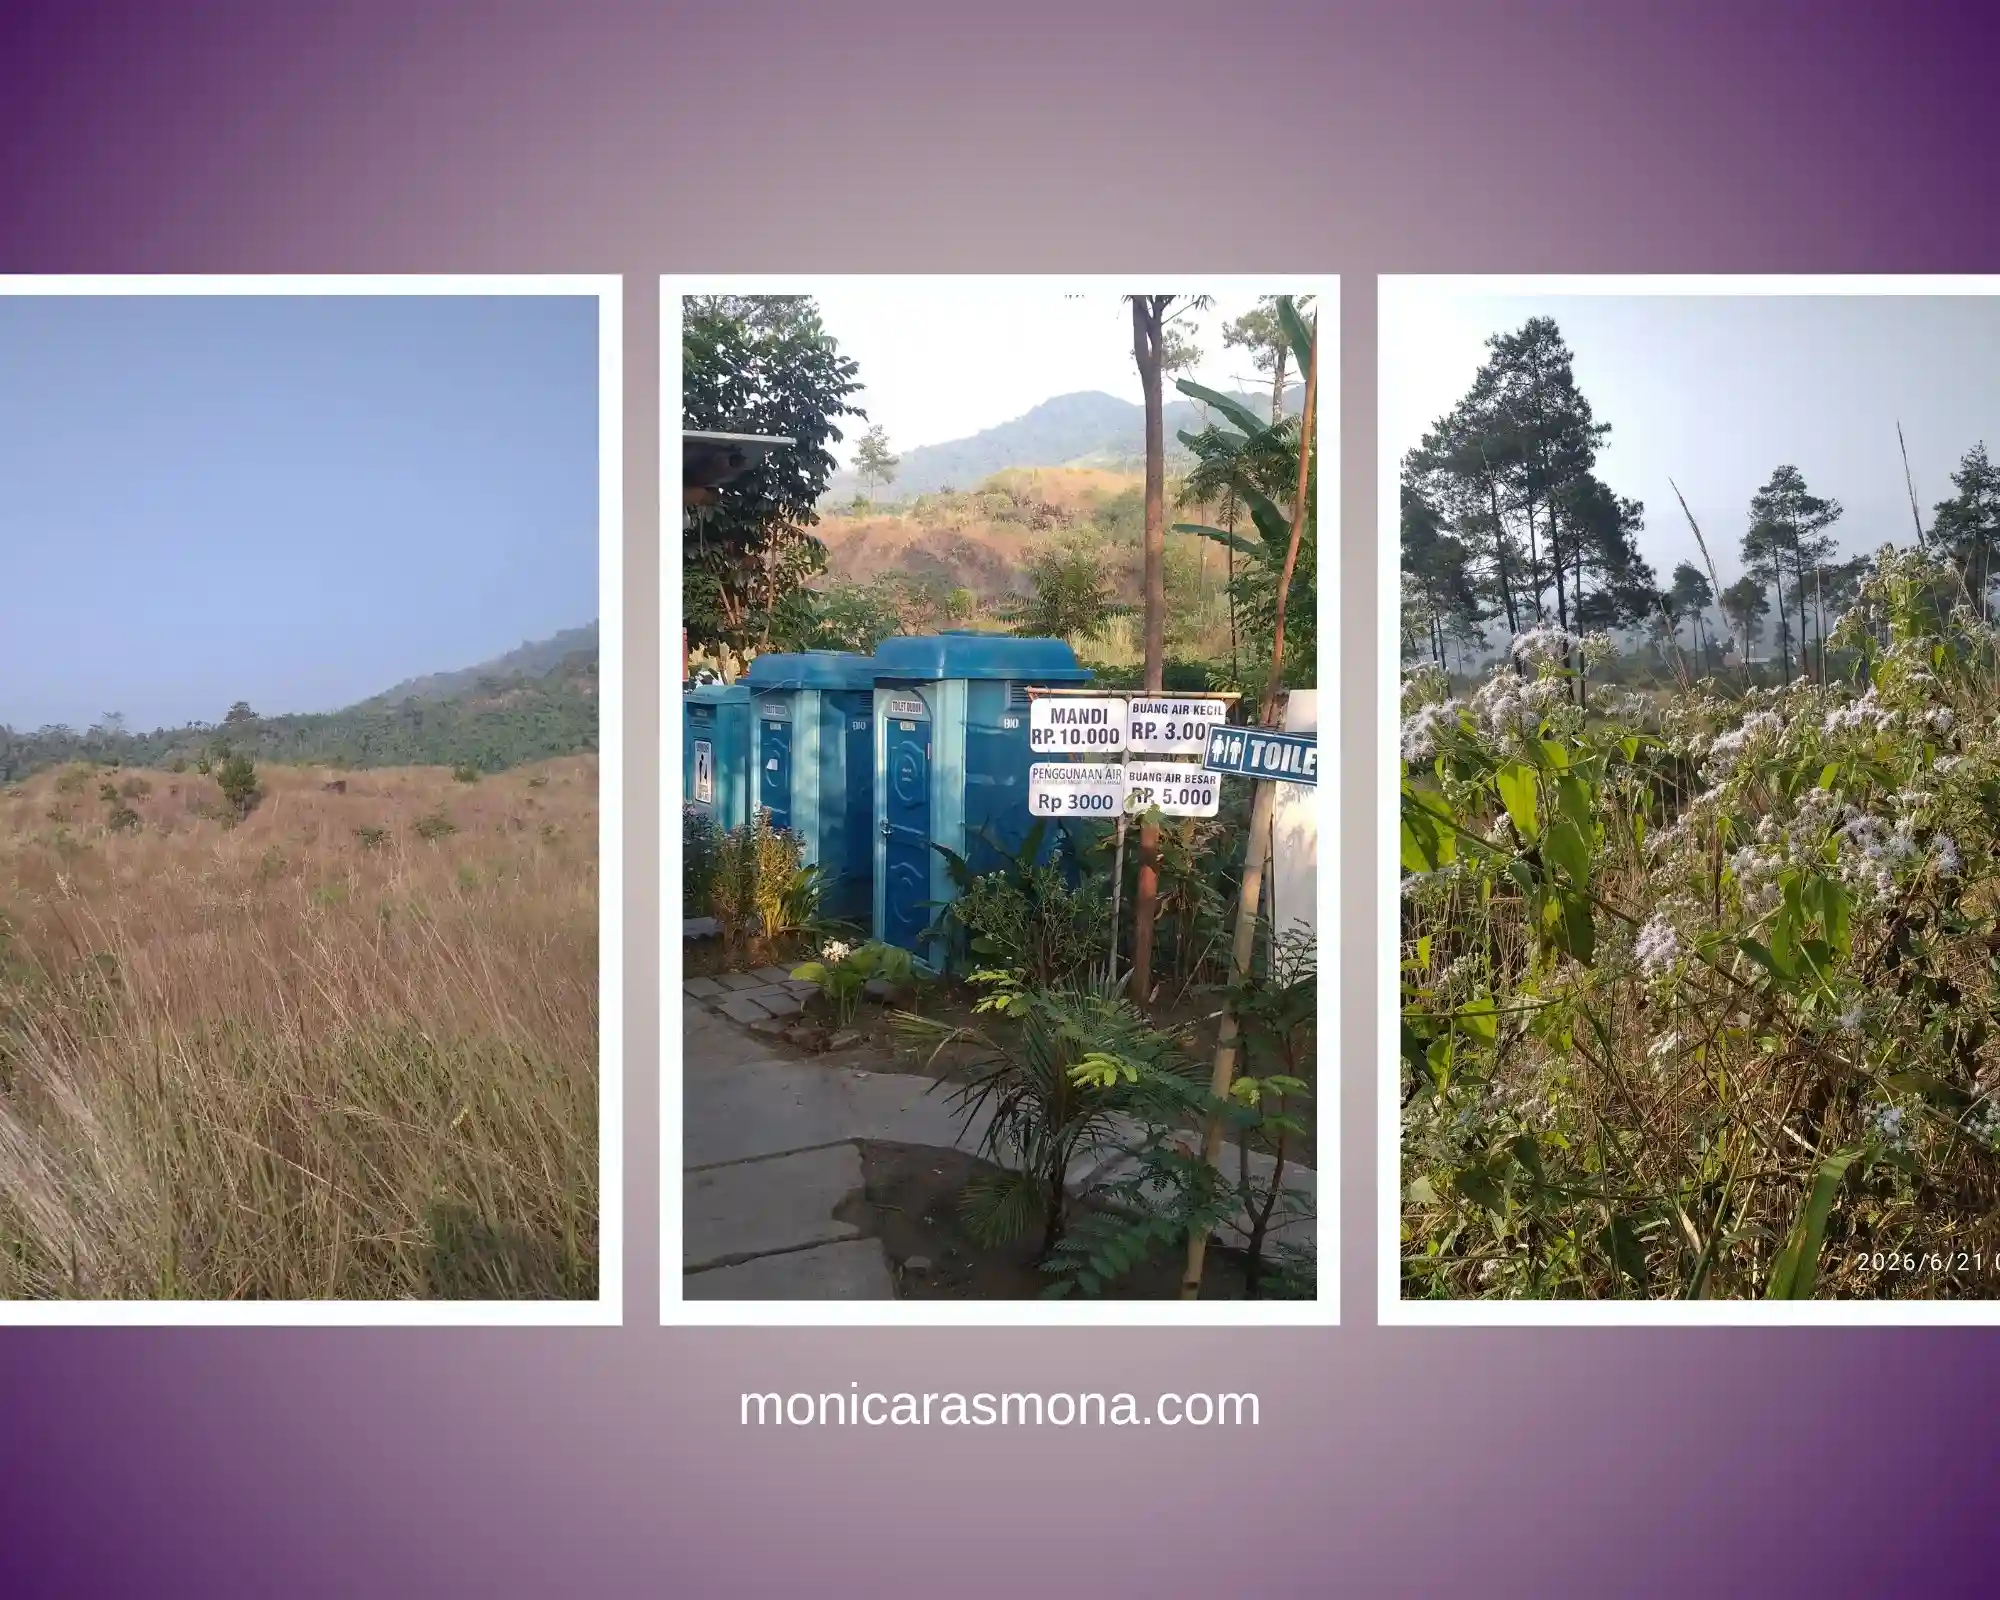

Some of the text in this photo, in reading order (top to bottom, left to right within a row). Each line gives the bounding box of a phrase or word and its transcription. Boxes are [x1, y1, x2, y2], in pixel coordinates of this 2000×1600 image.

[1050, 708, 1108, 724] MANDI
[1132, 703, 1224, 716] BUANG AIR KECIL
[1131, 722, 1206, 741] RP. 3.00
[1032, 767, 1122, 780] PENGGUNAAN AIR
[1129, 772, 1216, 785] BUANG AIR BESAR
[1038, 793, 1114, 812] Rp 3000
[1162, 788, 1212, 806] 5.000
